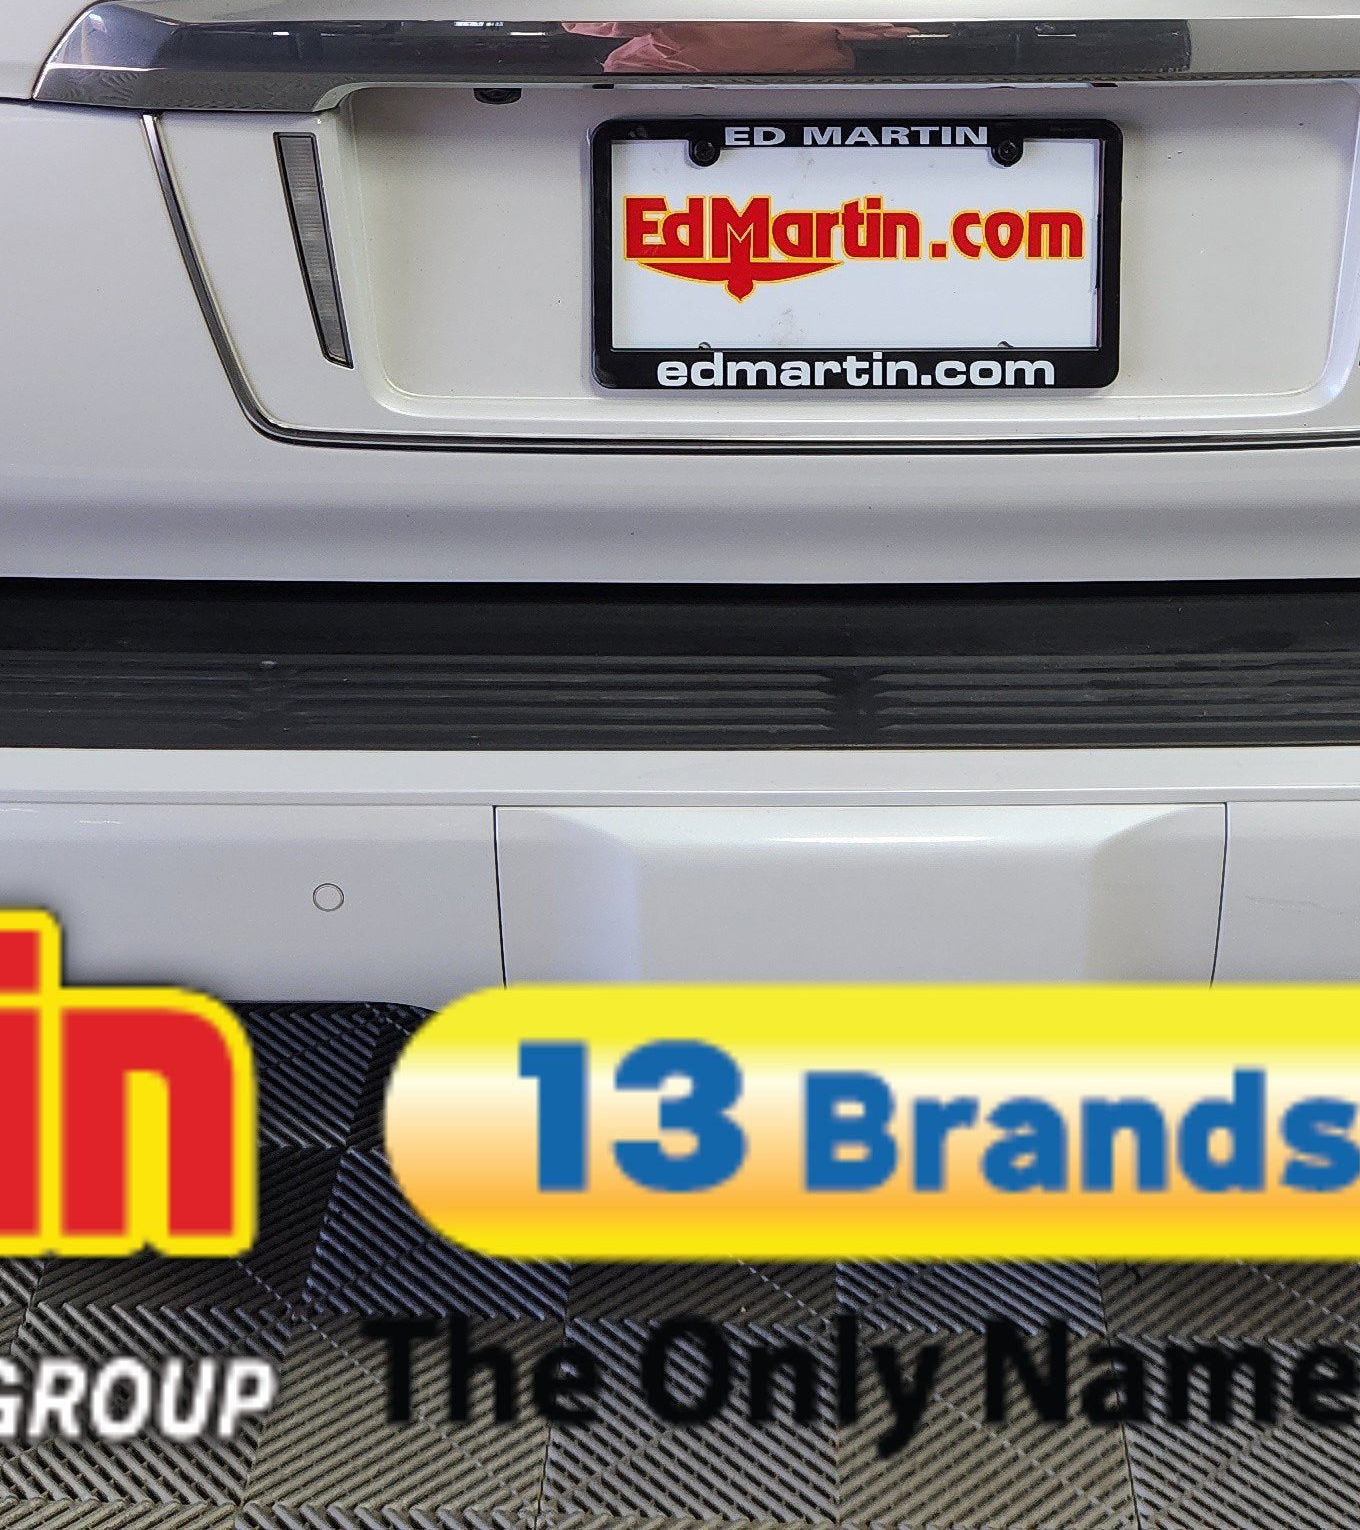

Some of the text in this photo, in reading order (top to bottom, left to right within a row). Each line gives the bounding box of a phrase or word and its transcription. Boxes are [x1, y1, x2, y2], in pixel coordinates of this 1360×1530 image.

[723, 125, 989, 147] ED MARTIN
[656, 351, 1056, 388] edmartin.com
